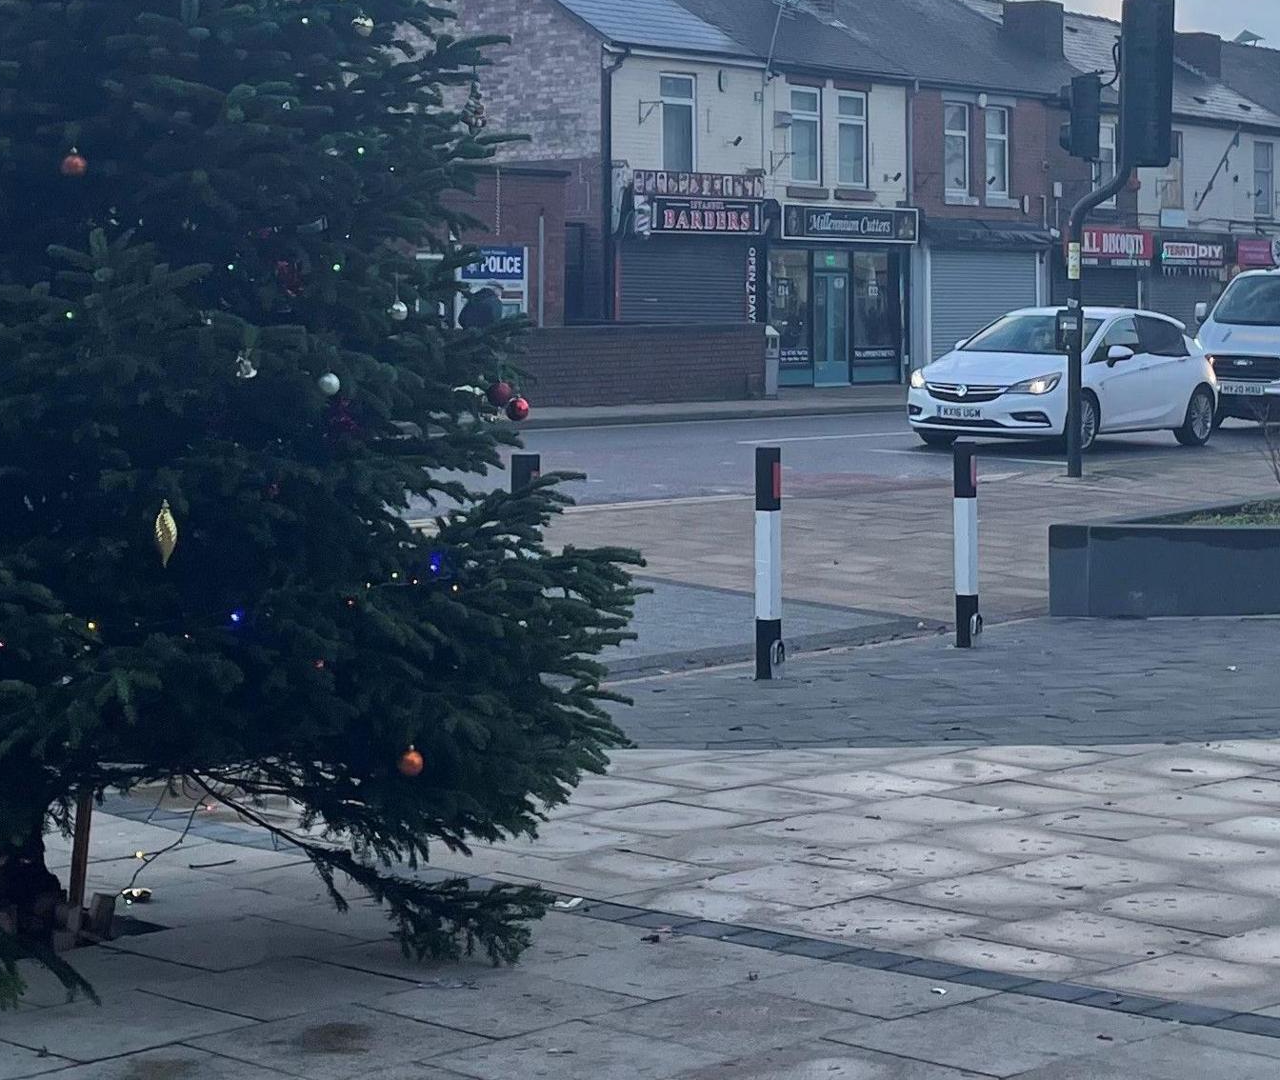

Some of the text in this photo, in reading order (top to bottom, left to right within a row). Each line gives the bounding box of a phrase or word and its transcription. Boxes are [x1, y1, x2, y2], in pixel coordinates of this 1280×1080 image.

[663, 209, 752, 231] BARBERS
[860, 216, 891, 234] Cutters
[1102, 232, 1144, 255] DISCOUNTS
[1198, 246, 1221, 258] DIY
[481, 255, 522, 274] POLICE
[748, 247, 757, 281] OPEN
